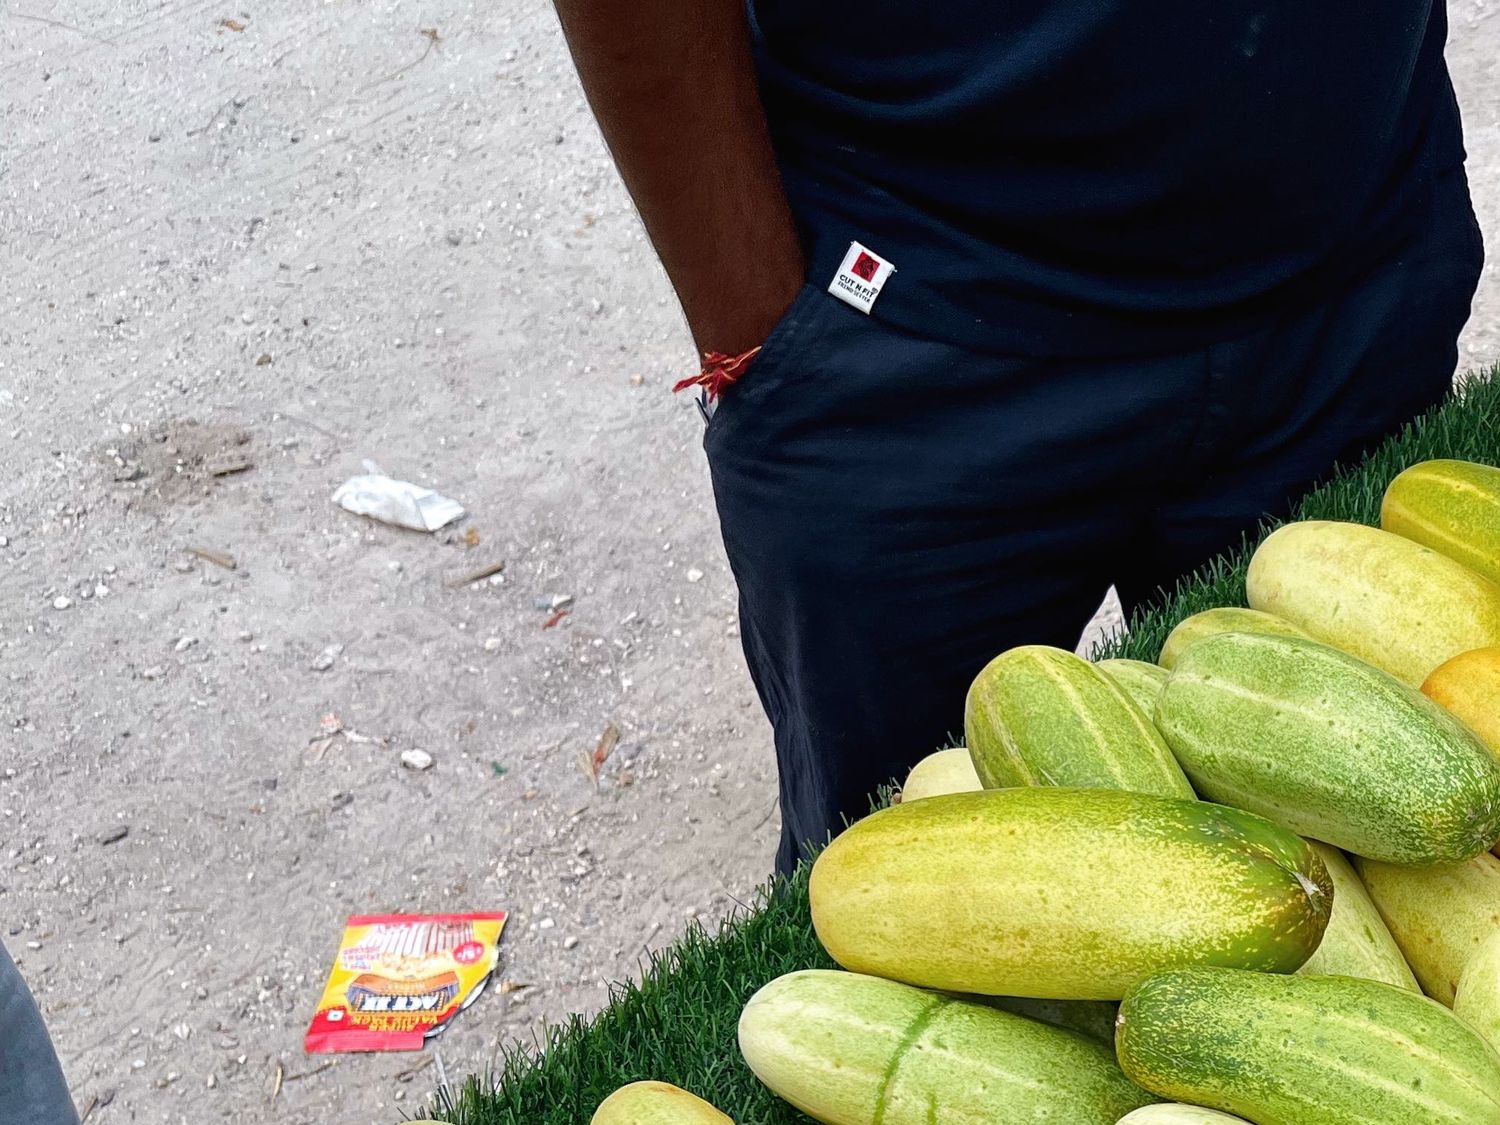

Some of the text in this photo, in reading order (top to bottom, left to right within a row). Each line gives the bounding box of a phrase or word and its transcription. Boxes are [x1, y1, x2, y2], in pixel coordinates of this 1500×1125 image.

[840, 274, 874, 298] CUT N FIT
[362, 994, 439, 1011] ACT II
